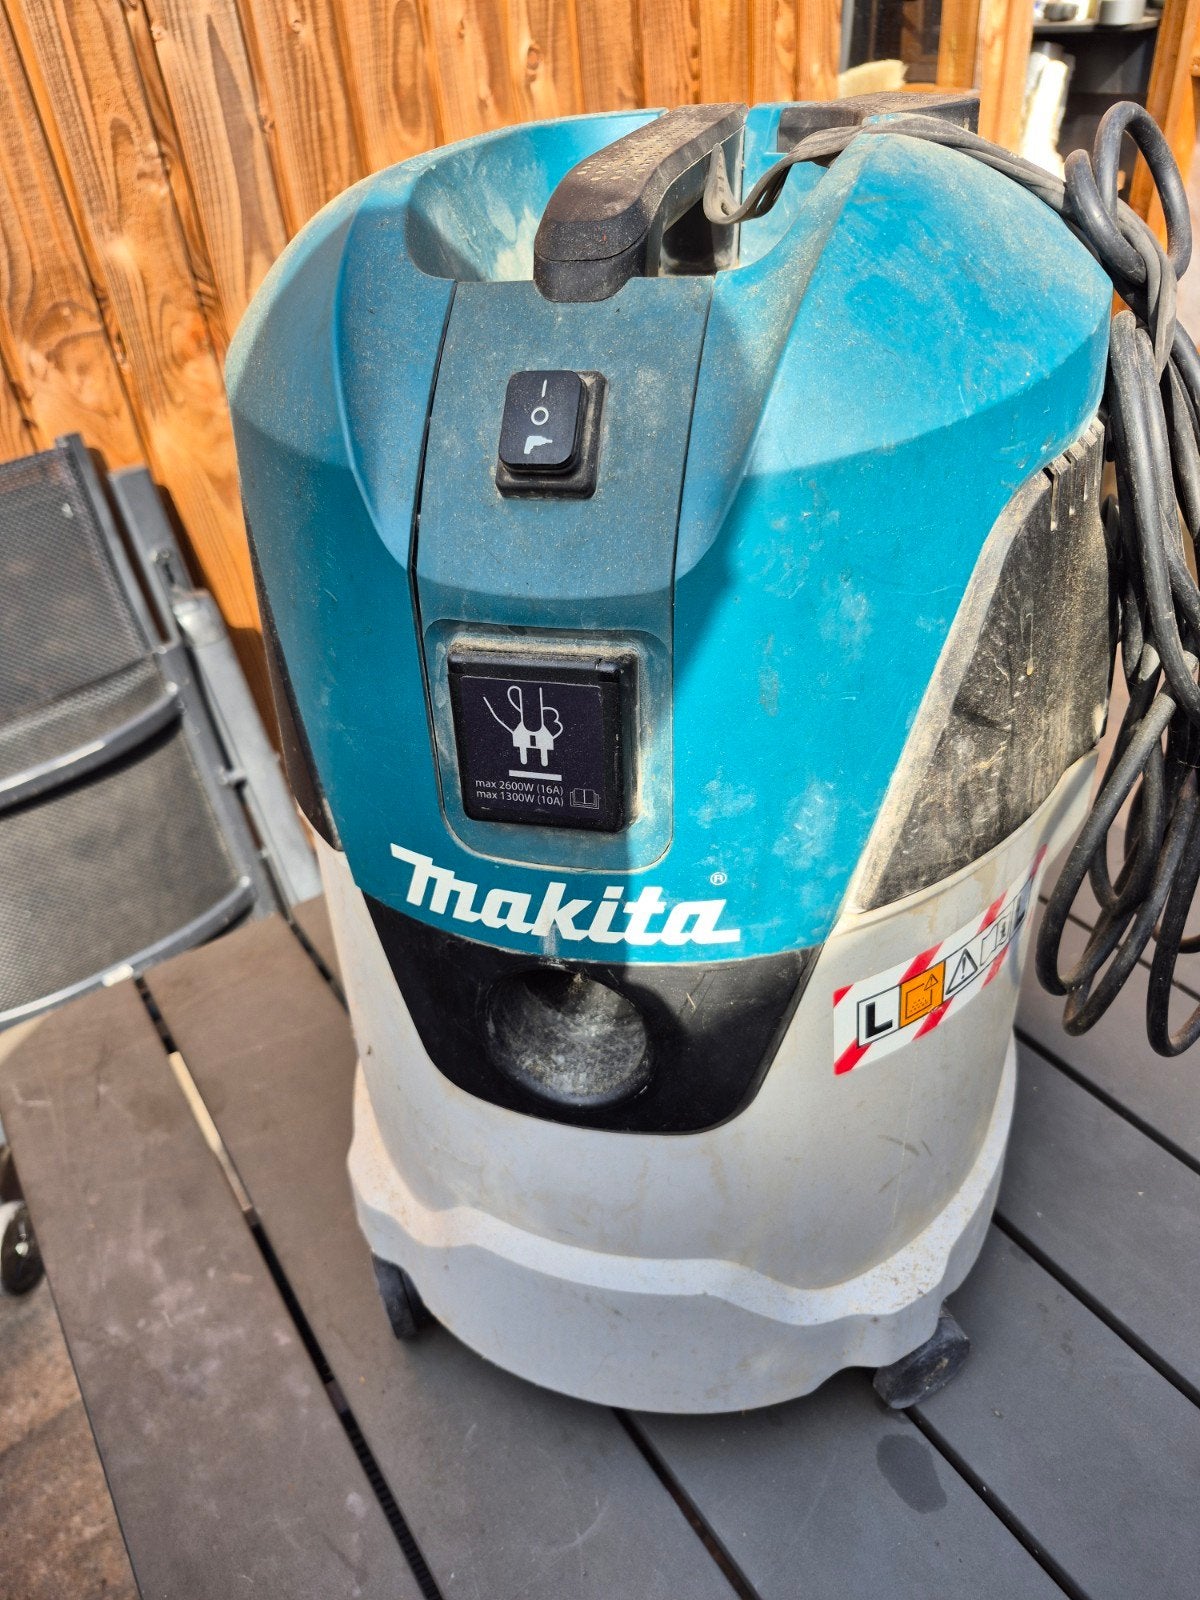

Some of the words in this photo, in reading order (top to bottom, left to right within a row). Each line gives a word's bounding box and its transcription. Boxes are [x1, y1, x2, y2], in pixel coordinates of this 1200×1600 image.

[475, 780, 497, 788] max
[499, 780, 534, 792] 2600W
[536, 783, 564, 796] (16A)
[476, 790, 498, 799] max
[500, 791, 535, 803] 1300W
[537, 795, 564, 807] (10A)
[866, 1002, 893, 1038] L
